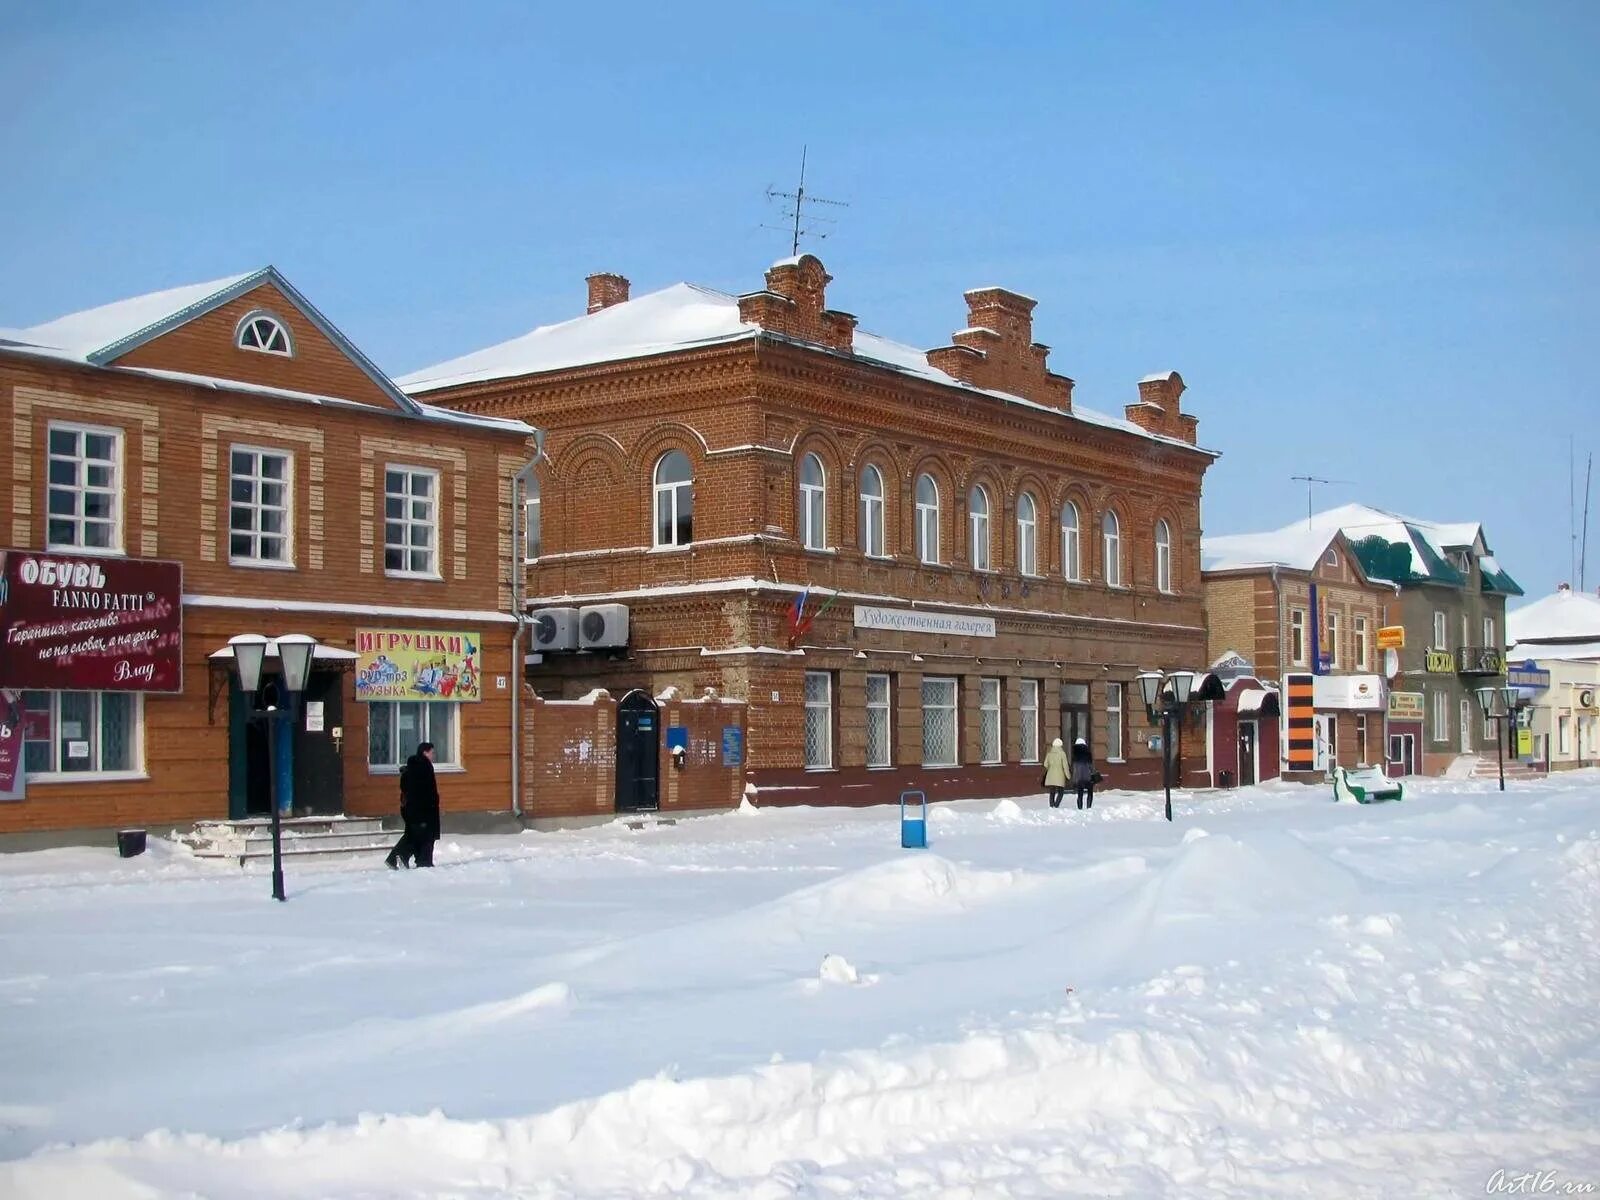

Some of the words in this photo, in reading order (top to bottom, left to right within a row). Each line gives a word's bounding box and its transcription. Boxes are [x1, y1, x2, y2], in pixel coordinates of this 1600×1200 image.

[21, 558, 106, 588] ОБУВЬ
[53, 589, 100, 609] FANNO
[7, 624, 68, 646] Гарантия,
[71, 611, 119, 633] качество
[859, 608, 951, 630] Художественная
[954, 622, 992, 636] галерея
[359, 632, 462, 656] ИГРУШКИ
[113, 660, 155, 682] Влад
[360, 684, 407, 697] МУЗЫКА
